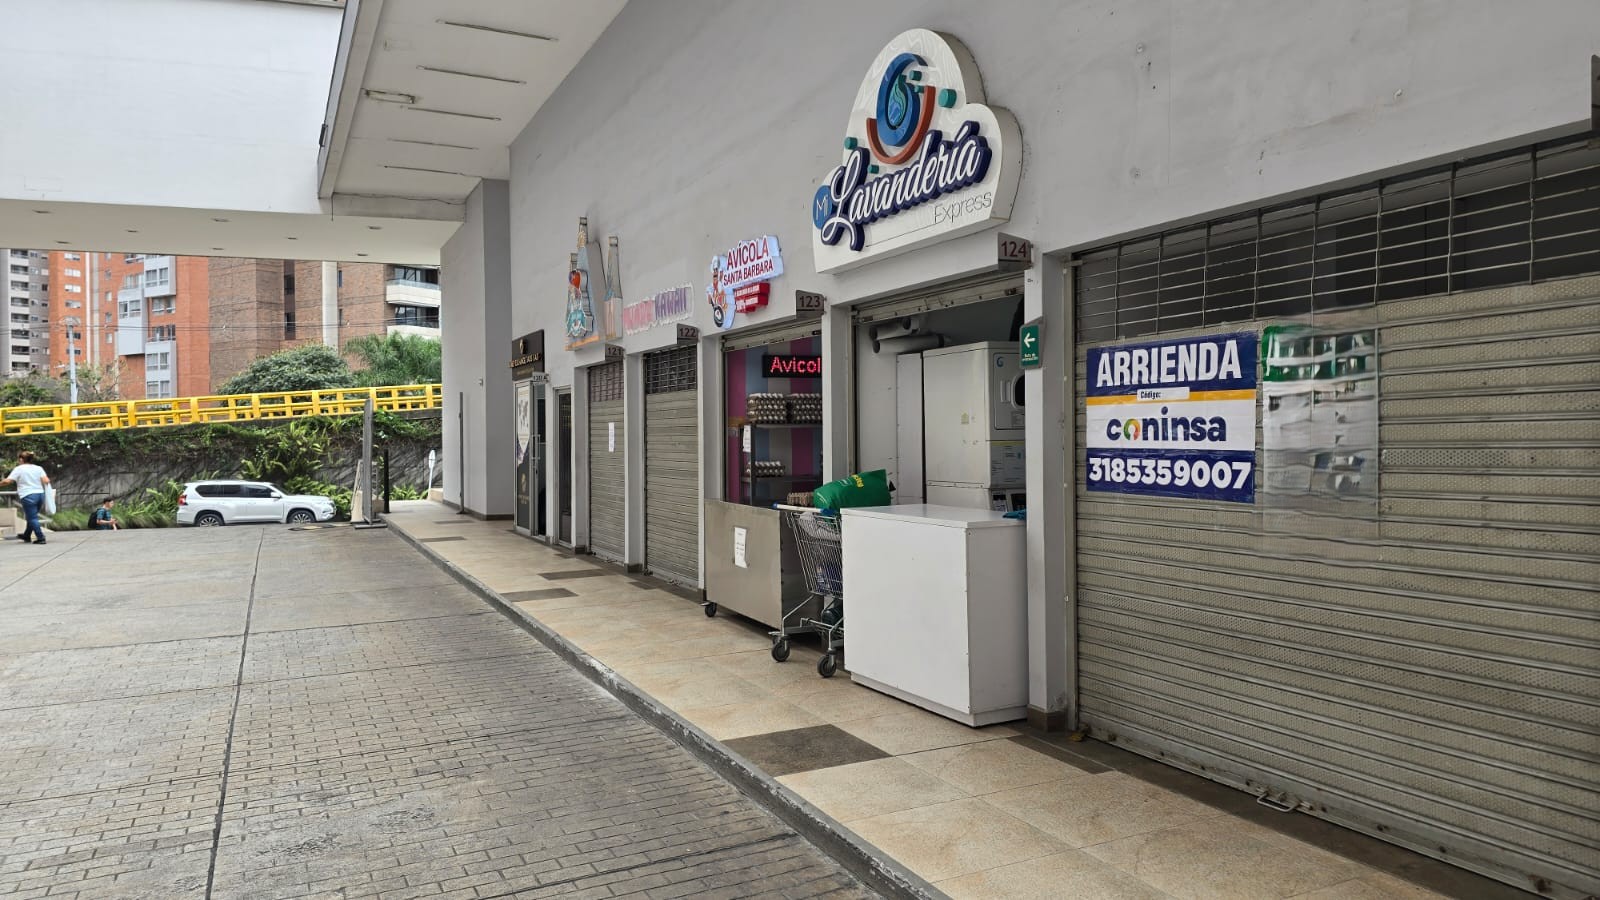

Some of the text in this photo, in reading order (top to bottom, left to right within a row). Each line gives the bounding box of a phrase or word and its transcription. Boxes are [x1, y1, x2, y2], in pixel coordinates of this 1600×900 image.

[820, 122, 991, 251] Lavandería
[933, 191, 993, 225] Express
[727, 237, 769, 271] AVÍCOLA
[1001, 240, 1028, 257] 124
[723, 258, 774, 286] SANTA BARBARA
[799, 296, 822, 308] 123
[680, 327, 697, 338] 122
[607, 347, 623, 357] 121
[1096, 340, 1243, 388] ARRIENDA
[1140, 391, 1161, 400] Código:
[1106, 406, 1227, 442] coninsa
[1089, 458, 1252, 490] 3185359007
